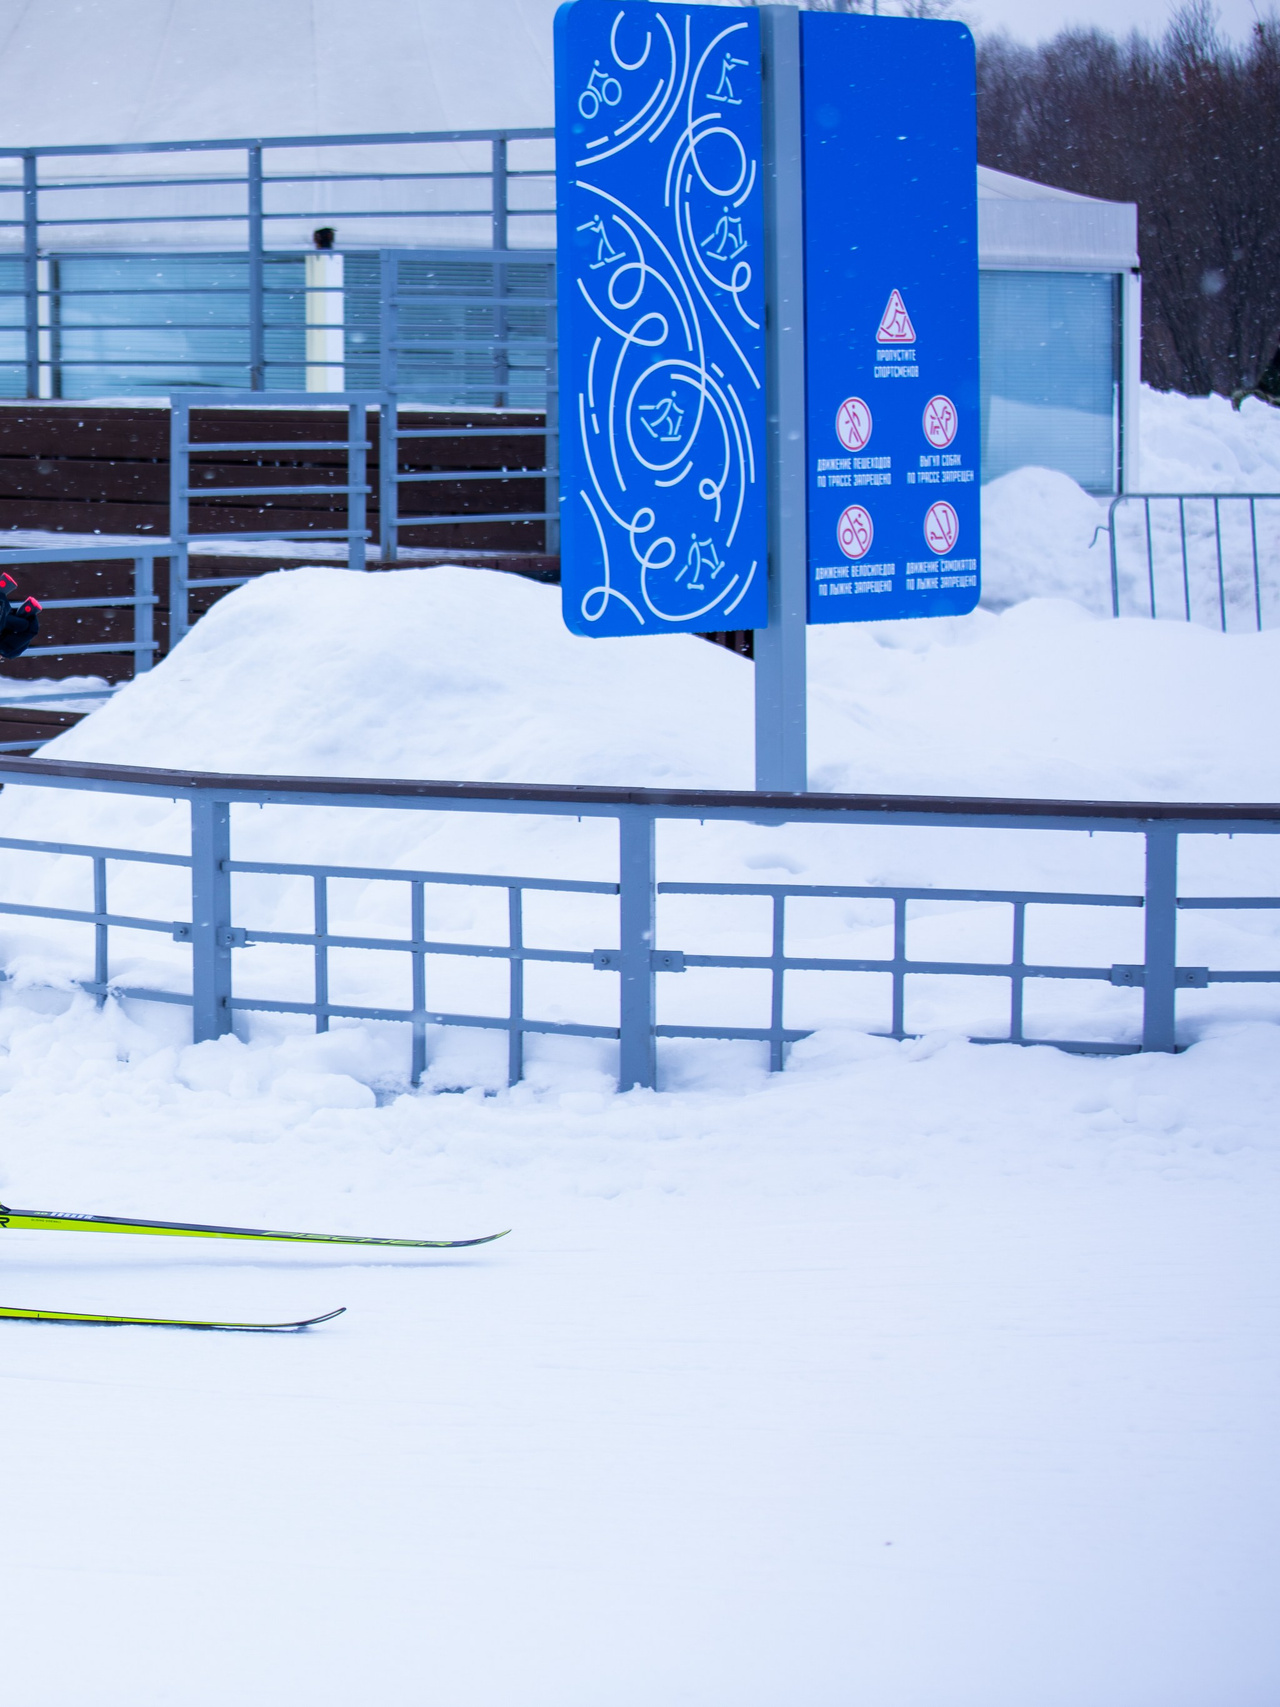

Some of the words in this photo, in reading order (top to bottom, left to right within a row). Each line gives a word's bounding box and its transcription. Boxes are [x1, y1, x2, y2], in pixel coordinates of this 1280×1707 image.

[876, 349, 916, 361] ПРОПУСТИТЕ
[874, 366, 919, 378] СПОРТСМЕНОВ
[817, 458, 851, 472] ДВИЖЕНИЕ
[853, 456, 891, 470] ПЕШЕХОДОВ
[919, 455, 940, 467] ВЫГУЛ
[941, 454, 962, 467] СОБАК
[817, 475, 827, 488] ПО
[828, 474, 852, 487] ТРАССЕ
[853, 473, 892, 486] ЗАПРЕЩЕНО
[906, 472, 916, 484] ПО
[917, 471, 940, 484] ТРАССЕ
[815, 566, 849, 580] ДВИЖЕНИЕ
[851, 563, 895, 577] ВЕЛОСИПЕДОВ
[906, 561, 939, 575] ДВИЖЕНИЕ
[940, 559, 976, 572] САМОКАТОВ
[818, 584, 828, 596] ПО
[829, 582, 853, 595] ЛЫЖНЕ
[854, 580, 892, 594] ЗАПРЕЩЕНО
[906, 578, 915, 590] ПО
[916, 577, 939, 590] ЛЫЖНЕ
[940, 575, 976, 589] ЗАПРЕЩЕНО
